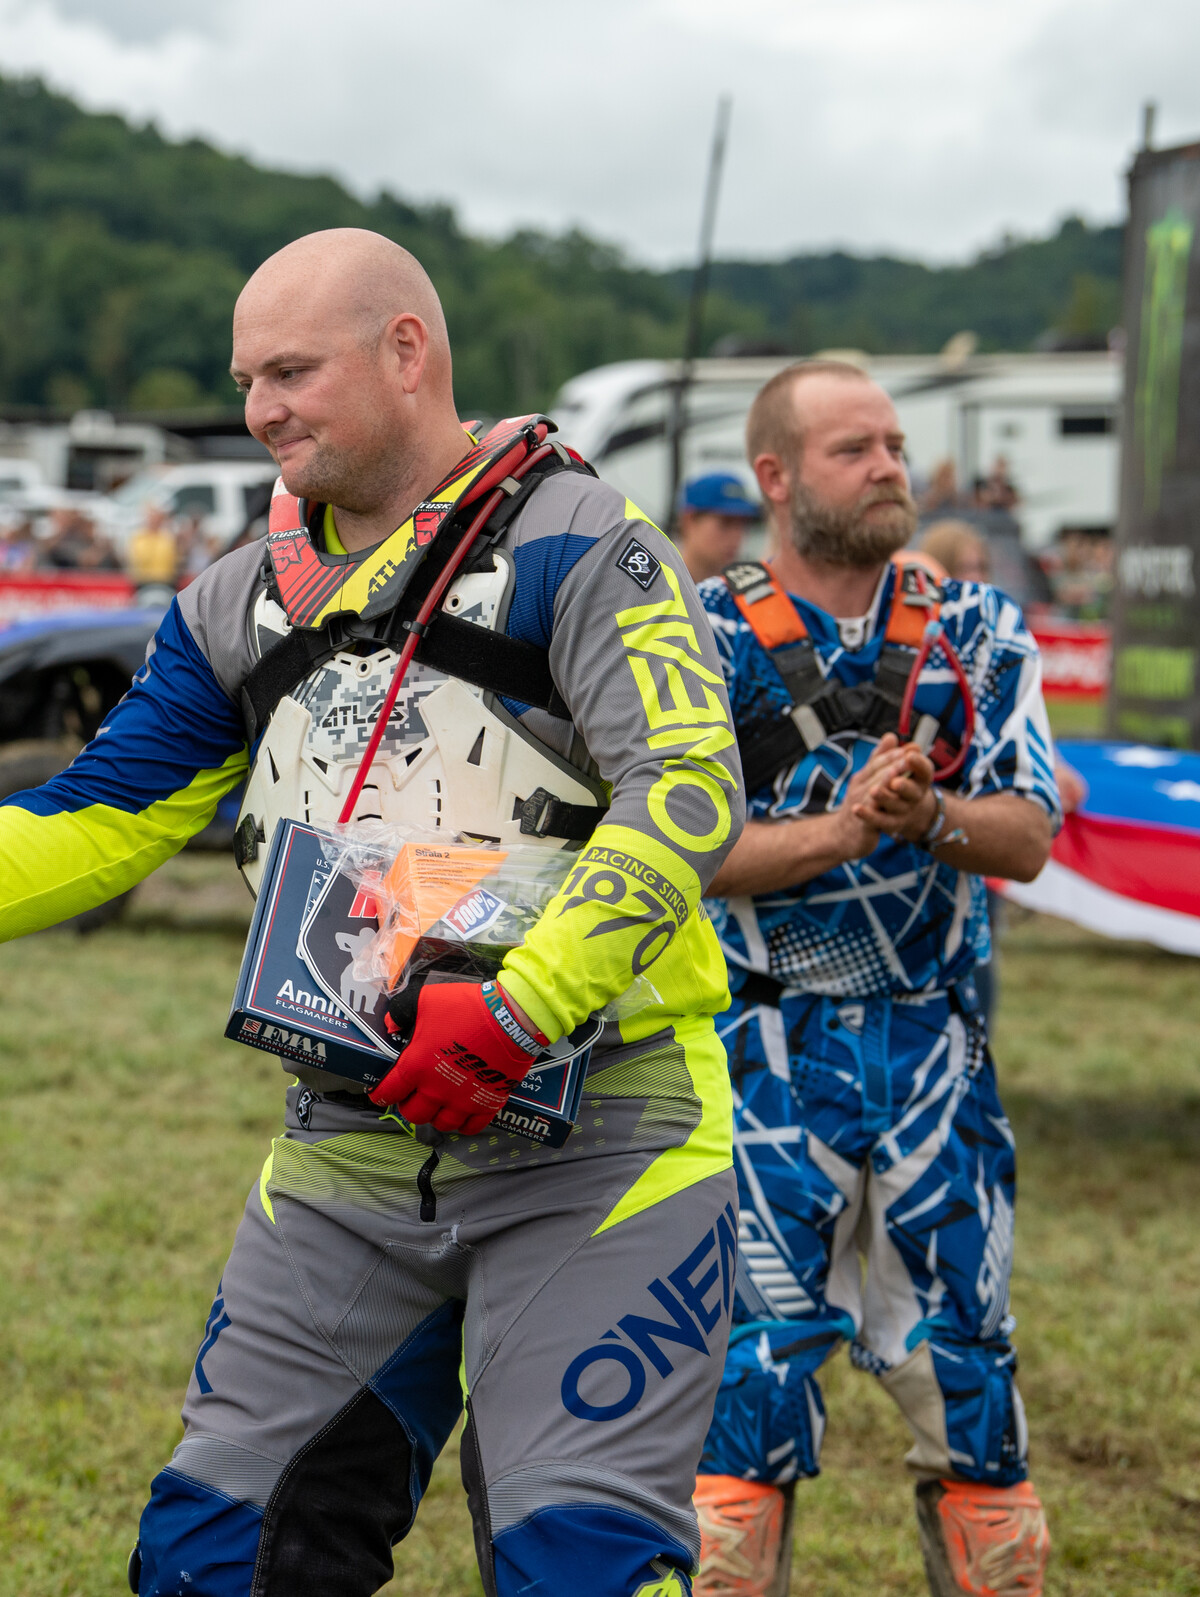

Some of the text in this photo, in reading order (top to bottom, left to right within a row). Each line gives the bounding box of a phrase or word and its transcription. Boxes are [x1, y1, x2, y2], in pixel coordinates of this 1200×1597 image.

[272, 529, 303, 540] TUSK
[316, 858, 330, 870] U.S.
[415, 848, 443, 859] Strata
[444, 851, 451, 859] 2
[588, 848, 688, 923] RACING SINCE
[453, 890, 496, 931] 100%
[555, 865, 676, 976] 1970
[275, 999, 349, 1029] FLAGMAKERS
[239, 1029, 327, 1062] FLAG MANUFACTURERS
[261, 1023, 327, 1059] FMAA
[494, 1005, 544, 1057] NTAINEER
[520, 1082, 542, 1093] 847
[491, 1121, 545, 1142] AGMAKERS
[561, 1201, 738, 1423] O'NEA
